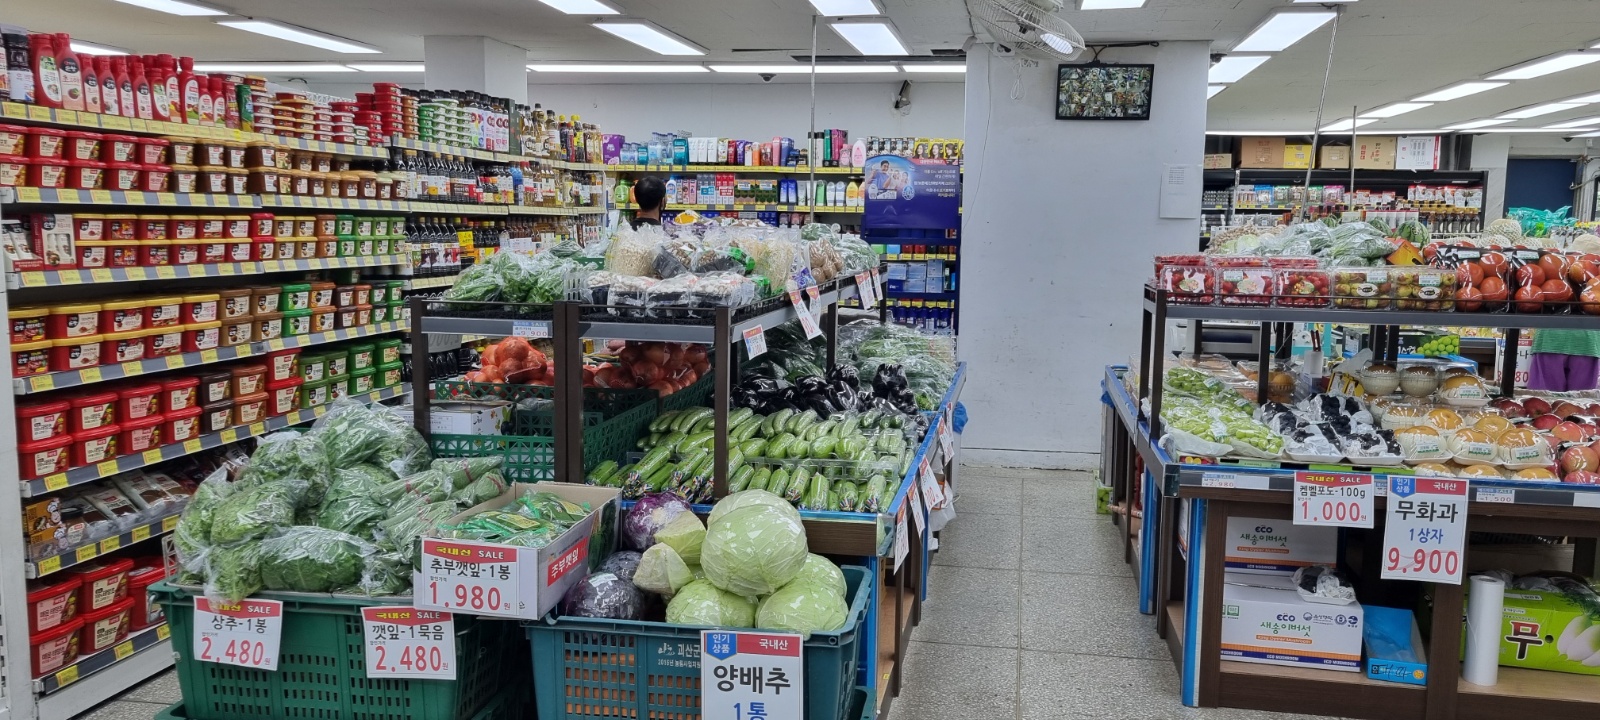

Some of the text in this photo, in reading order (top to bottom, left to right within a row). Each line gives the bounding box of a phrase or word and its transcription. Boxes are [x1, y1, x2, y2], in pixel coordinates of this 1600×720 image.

[1340, 476, 1361, 484] SALE
[1397, 478, 1410, 486] 인기
[1433, 482, 1457, 491] 국내산
[1396, 486, 1410, 494] 상품
[1395, 501, 1458, 523] 무화과
[1255, 525, 1272, 534] ECO
[1410, 528, 1443, 545] 1상자
[1240, 533, 1287, 547] 새송이버섯
[436, 546, 504, 560] 국내산 SALE
[430, 559, 511, 581] 추부깻잎-1봉
[552, 547, 578, 579] 추부깻잎
[248, 605, 271, 614] SALE
[417, 611, 440, 619] SALE
[212, 615, 267, 634] 상추-1봉
[1277, 613, 1295, 622] ECO
[372, 624, 444, 641] 깻잎-1묶음
[1260, 622, 1311, 637] 새송이버섯
[713, 633, 730, 643] 인기
[759, 638, 788, 651] 국내산
[1505, 620, 1543, 660] 무
[678, 643, 700, 658] 괴산군
[712, 644, 730, 654] 상품
[714, 664, 790, 695] 양배추
